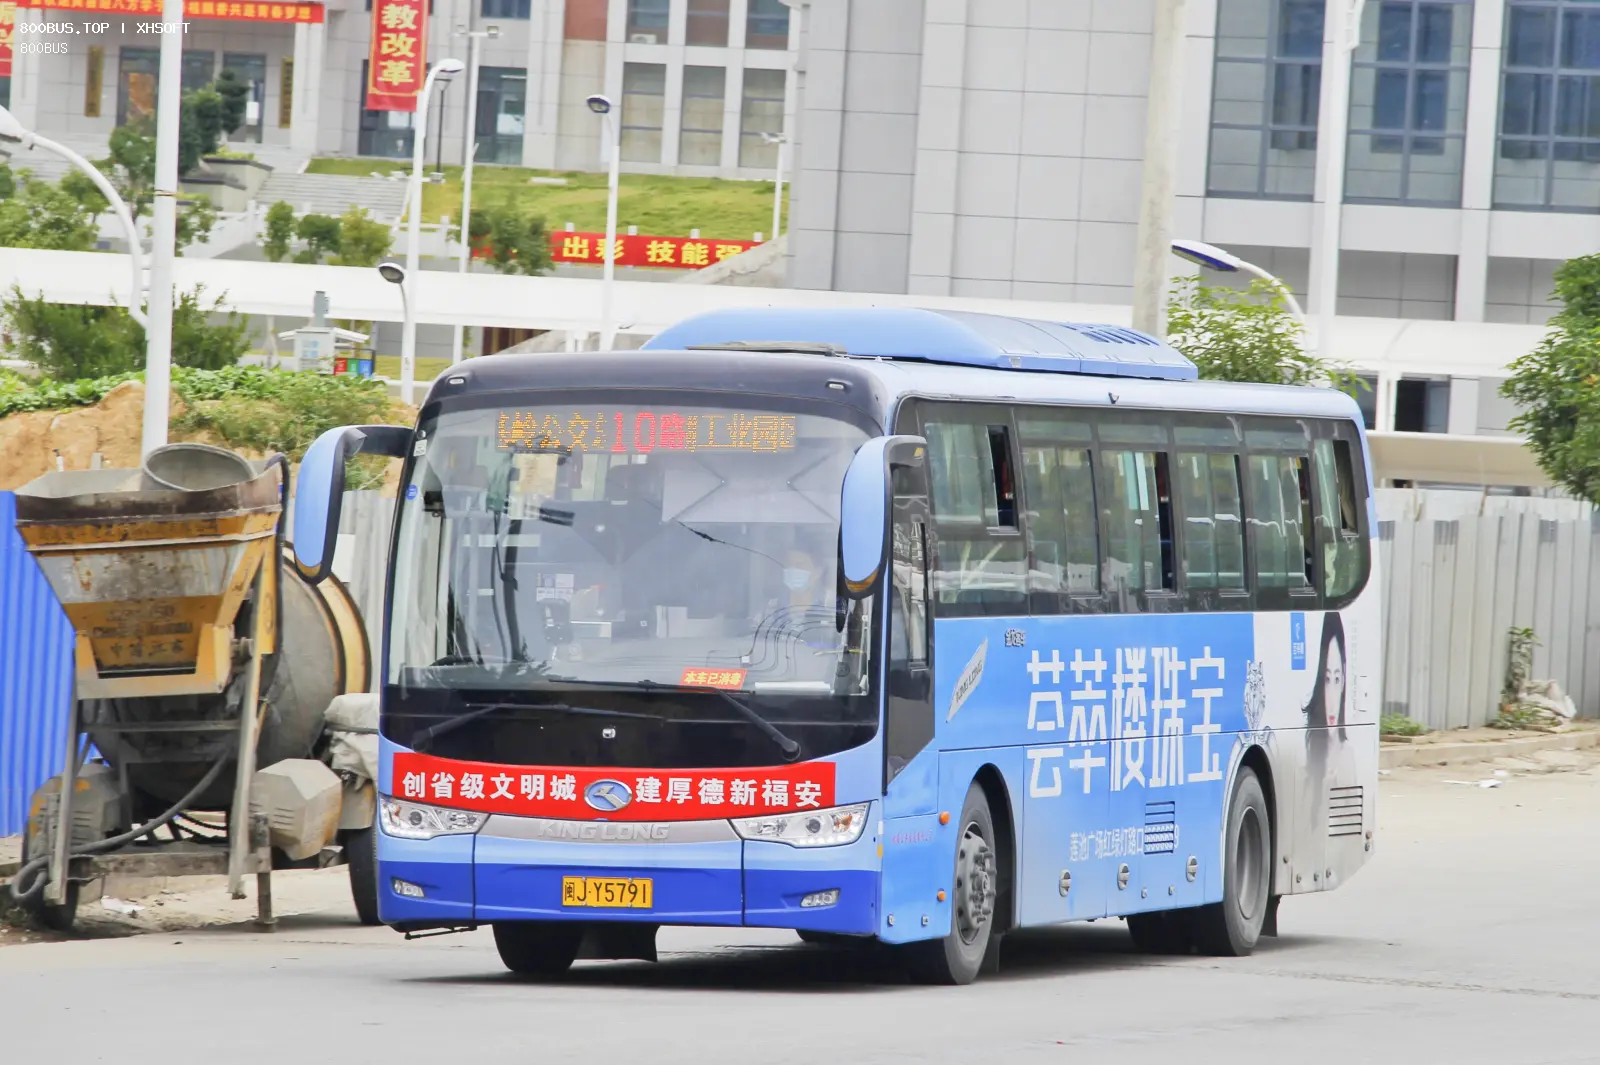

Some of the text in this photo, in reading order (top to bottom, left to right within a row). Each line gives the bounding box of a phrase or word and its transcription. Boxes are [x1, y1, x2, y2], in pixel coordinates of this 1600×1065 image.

[1027, 646, 1225, 798] 荟萃楼珠宝
[402, 771, 822, 808] 创省级文明城 建厚德新福安
[538, 820, 670, 841] KING LONG
